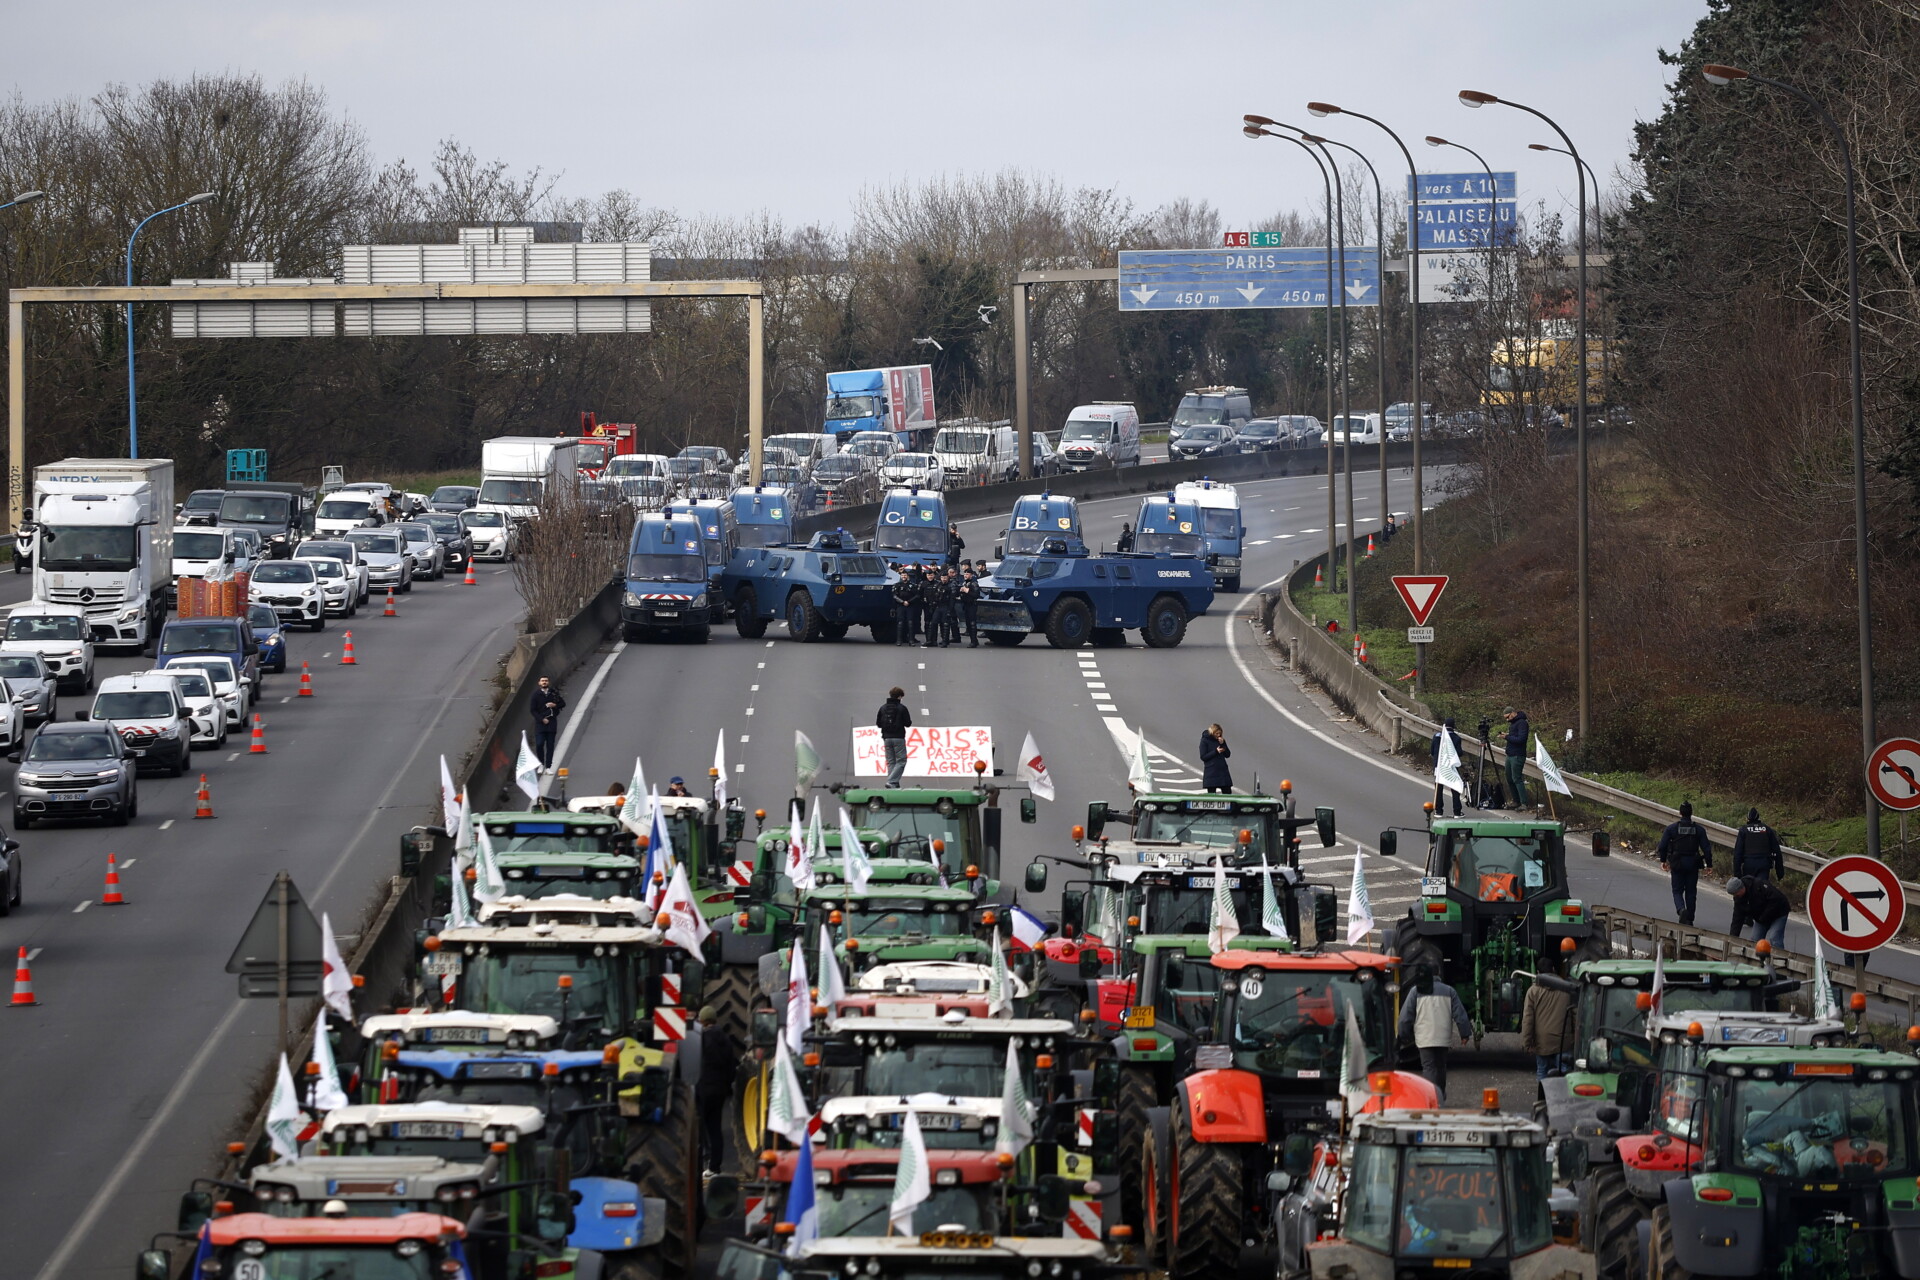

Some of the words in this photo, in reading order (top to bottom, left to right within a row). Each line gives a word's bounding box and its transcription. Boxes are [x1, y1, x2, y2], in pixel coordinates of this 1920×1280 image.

[1425, 184, 1452, 194] vers
[1463, 179, 1473, 194] A
[1479, 179, 1498, 193] 10
[1417, 207, 1510, 224] PALAISEAU
[1226, 233, 1234, 245] A
[1239, 233, 1247, 245] 6
[1252, 233, 1258, 245] E
[1265, 233, 1279, 245] 15
[1433, 228, 1491, 244] MASSY
[1226, 254, 1275, 270] PARIS
[1175, 292, 1203, 305] 450
[1208, 295, 1220, 304] m
[1282, 290, 1311, 302] 450
[1314, 293, 1326, 302] m
[885, 511, 906, 525] C1
[1015, 516, 1038, 530] B2
[1157, 570, 1192, 578] GENDARMERIE
[906, 727, 971, 749] ARIS
[926, 747, 981, 761] PASSER
[1430, 886, 1439, 894] 77
[1245, 981, 1259, 996] 40
[1425, 1130, 1456, 1143] 13176
[1466, 1130, 1480, 1143] 45
[241, 1263, 260, 1280] 50
